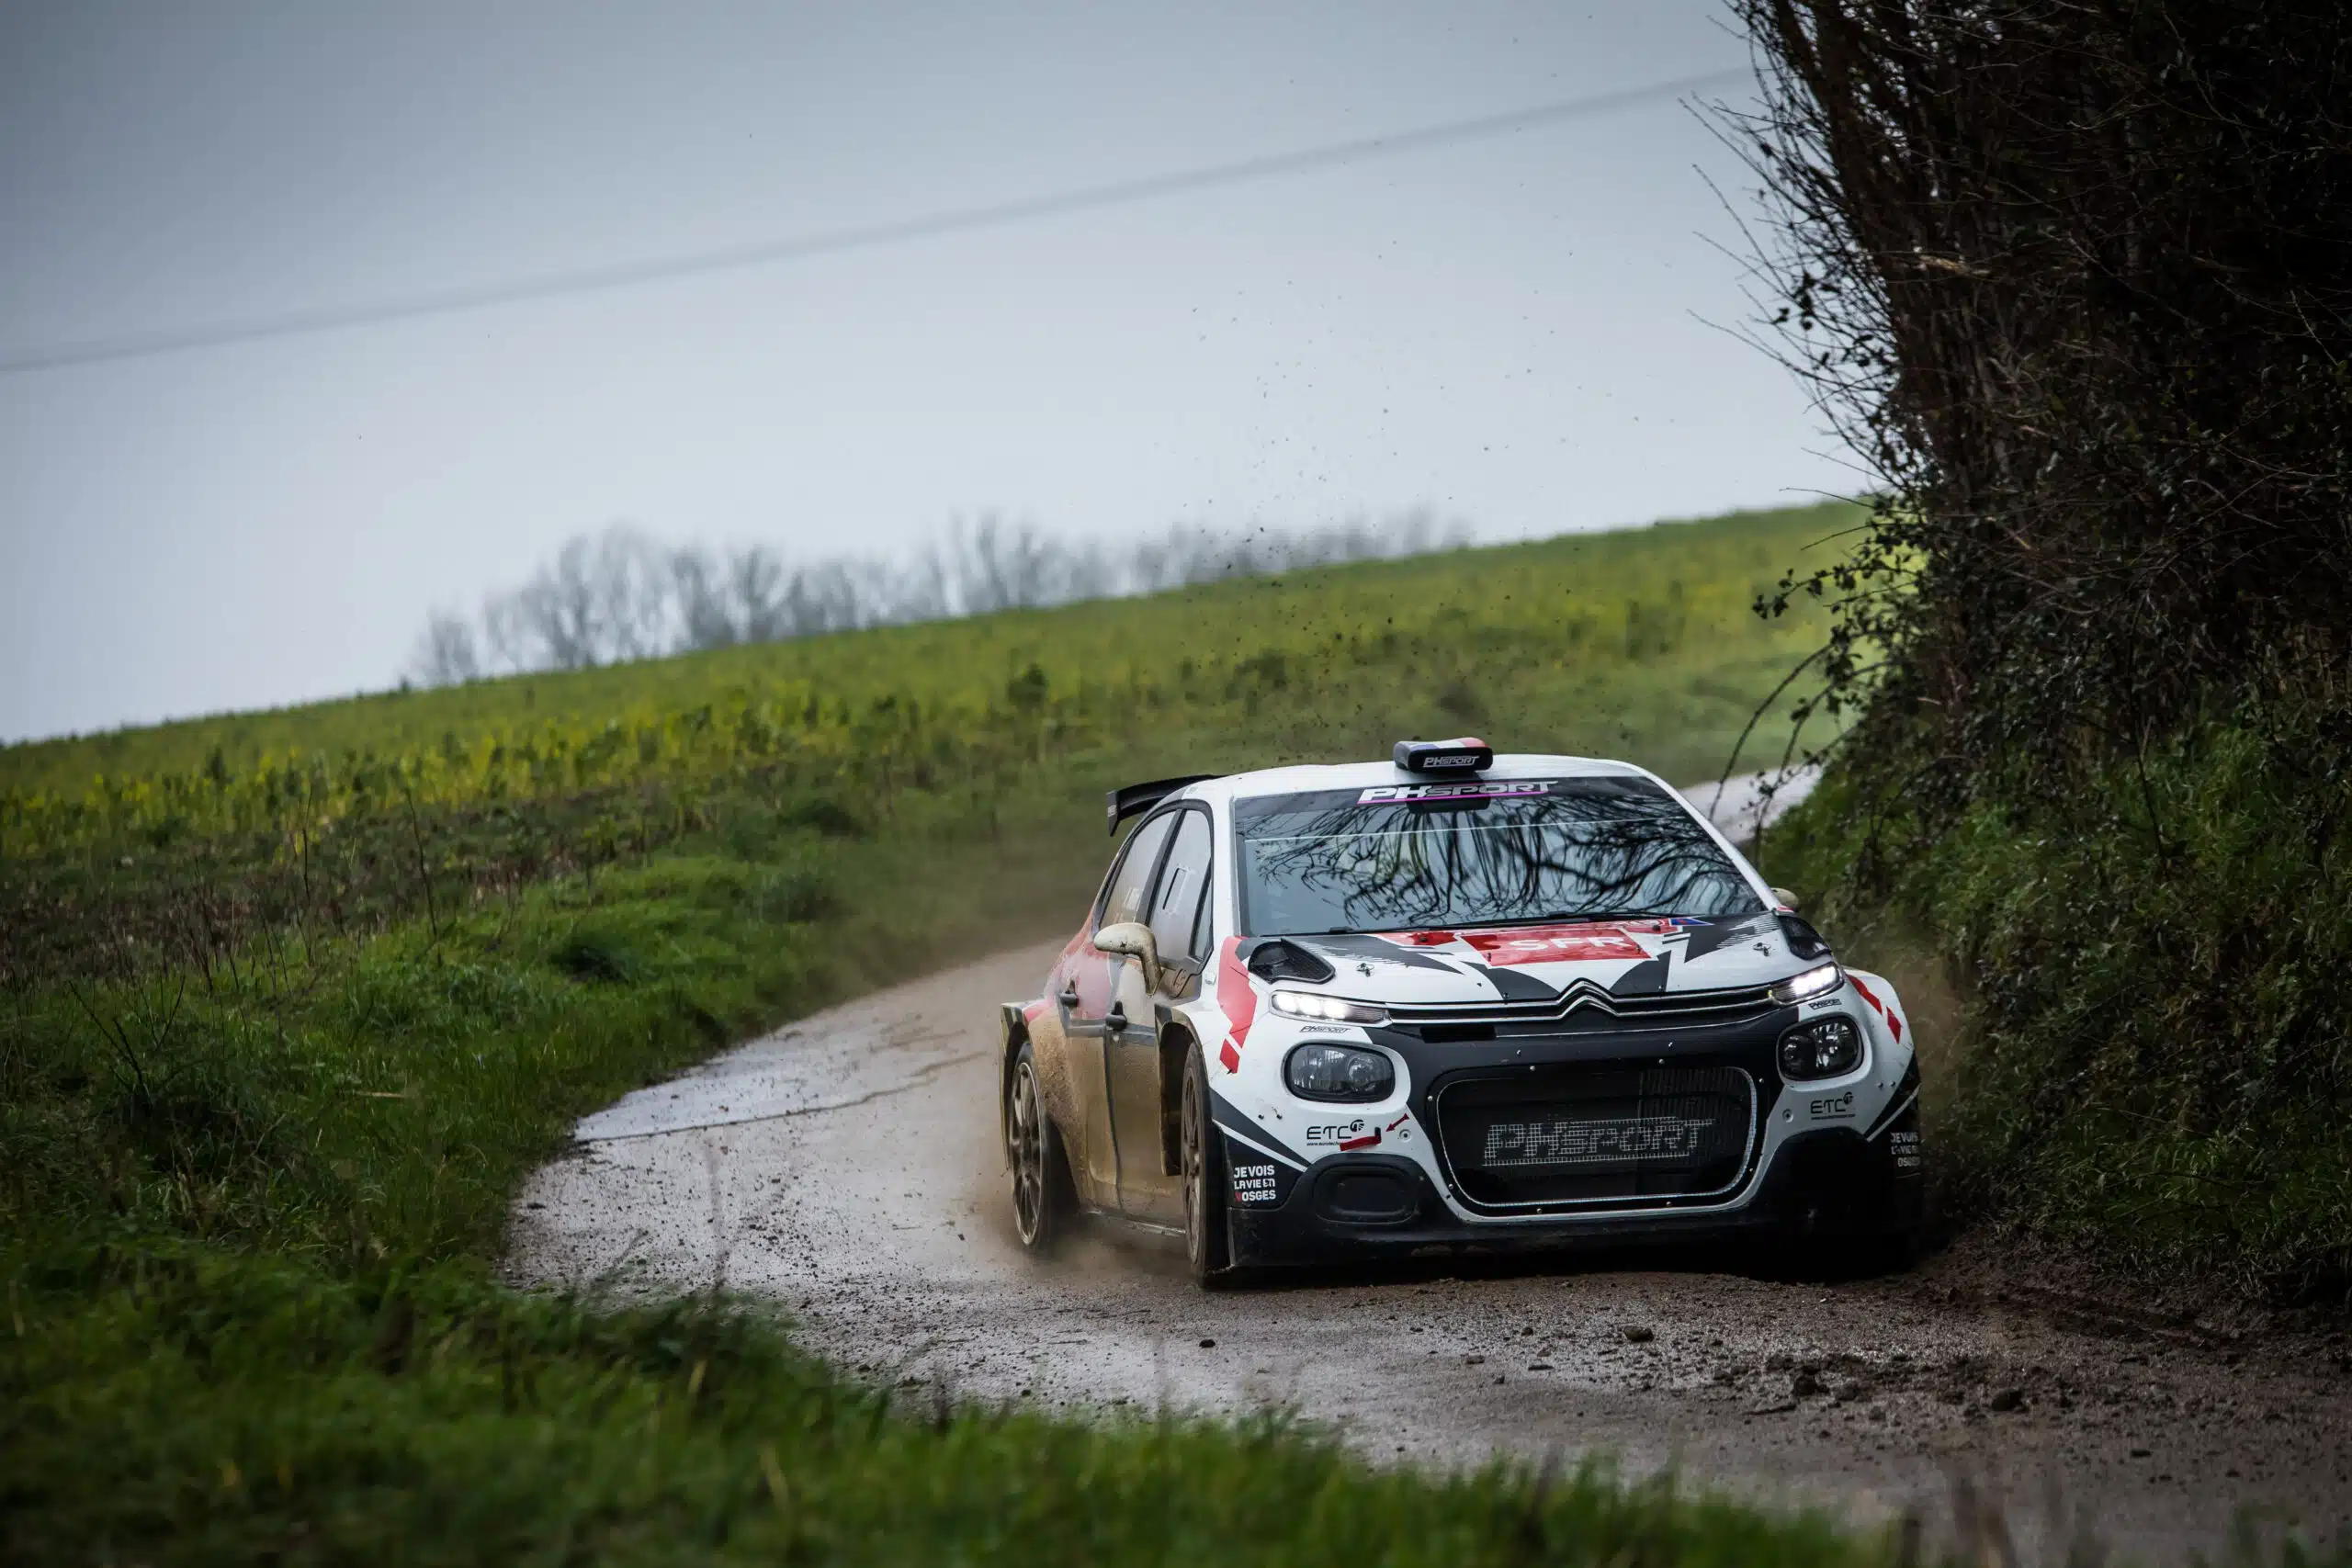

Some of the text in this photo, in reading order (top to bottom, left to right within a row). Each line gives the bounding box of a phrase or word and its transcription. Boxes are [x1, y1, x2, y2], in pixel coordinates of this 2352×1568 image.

[1423, 755, 1480, 767] PHSPORT
[1358, 781, 1559, 803] PHSPORT
[1509, 935, 1633, 951] SFR
[1811, 1098, 1846, 1113] ETC
[1306, 1125, 1352, 1140] ETC
[1483, 1117, 1715, 1166] PHSPORT
[1233, 1165, 1275, 1179] JE VOIS
[1234, 1180, 1246, 1190] LA
[1246, 1179, 1261, 1189] VIE
[1234, 1190, 1277, 1202] VOSGES
